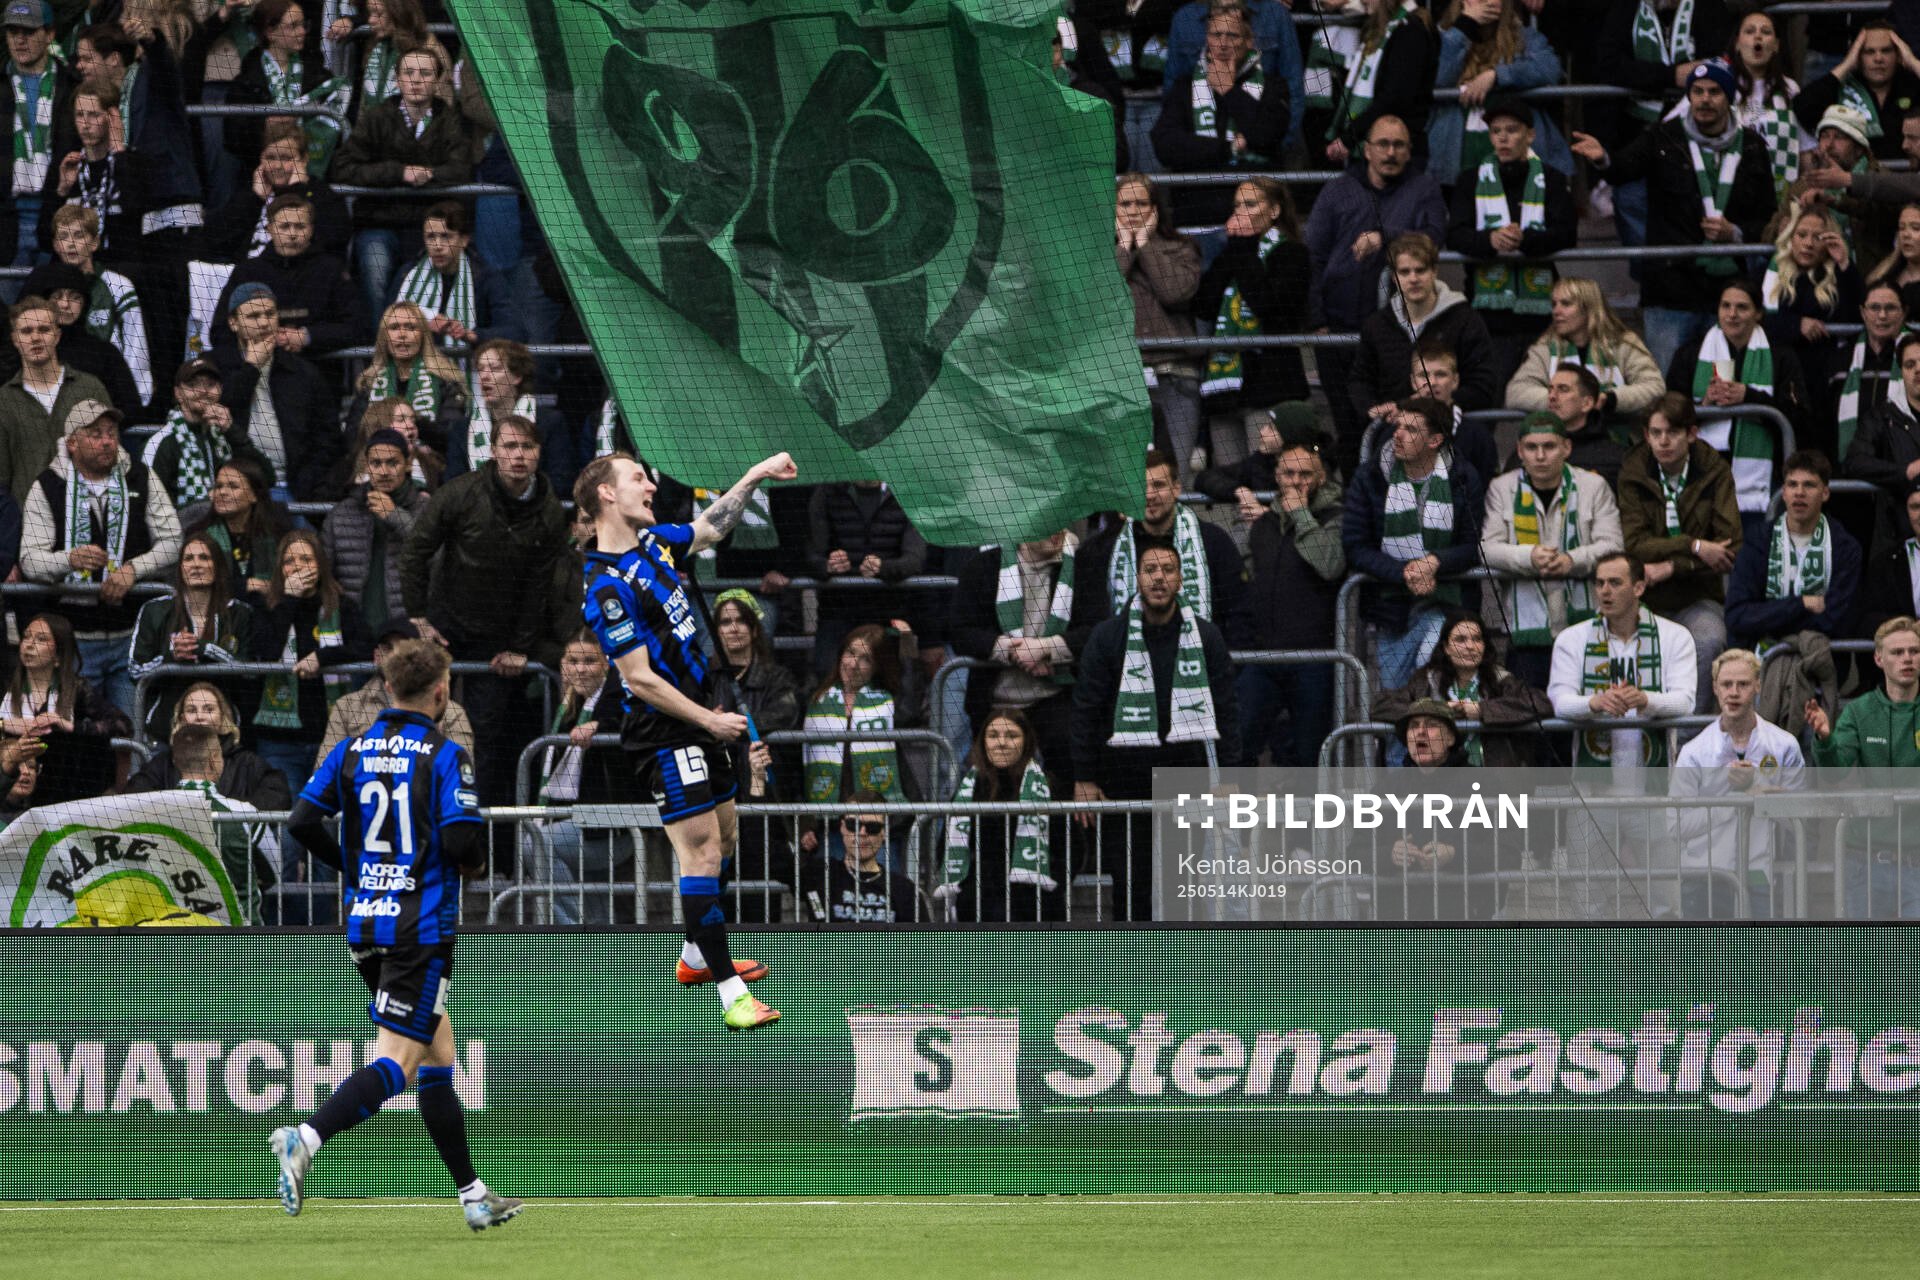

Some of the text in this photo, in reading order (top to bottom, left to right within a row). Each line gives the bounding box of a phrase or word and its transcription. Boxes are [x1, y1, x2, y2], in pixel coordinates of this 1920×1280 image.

[404, 738, 434, 755] TAK
[360, 780, 413, 854] 21
[913, 1026, 954, 1093] S
[1045, 1003, 1920, 1114] Stena Fastighe
